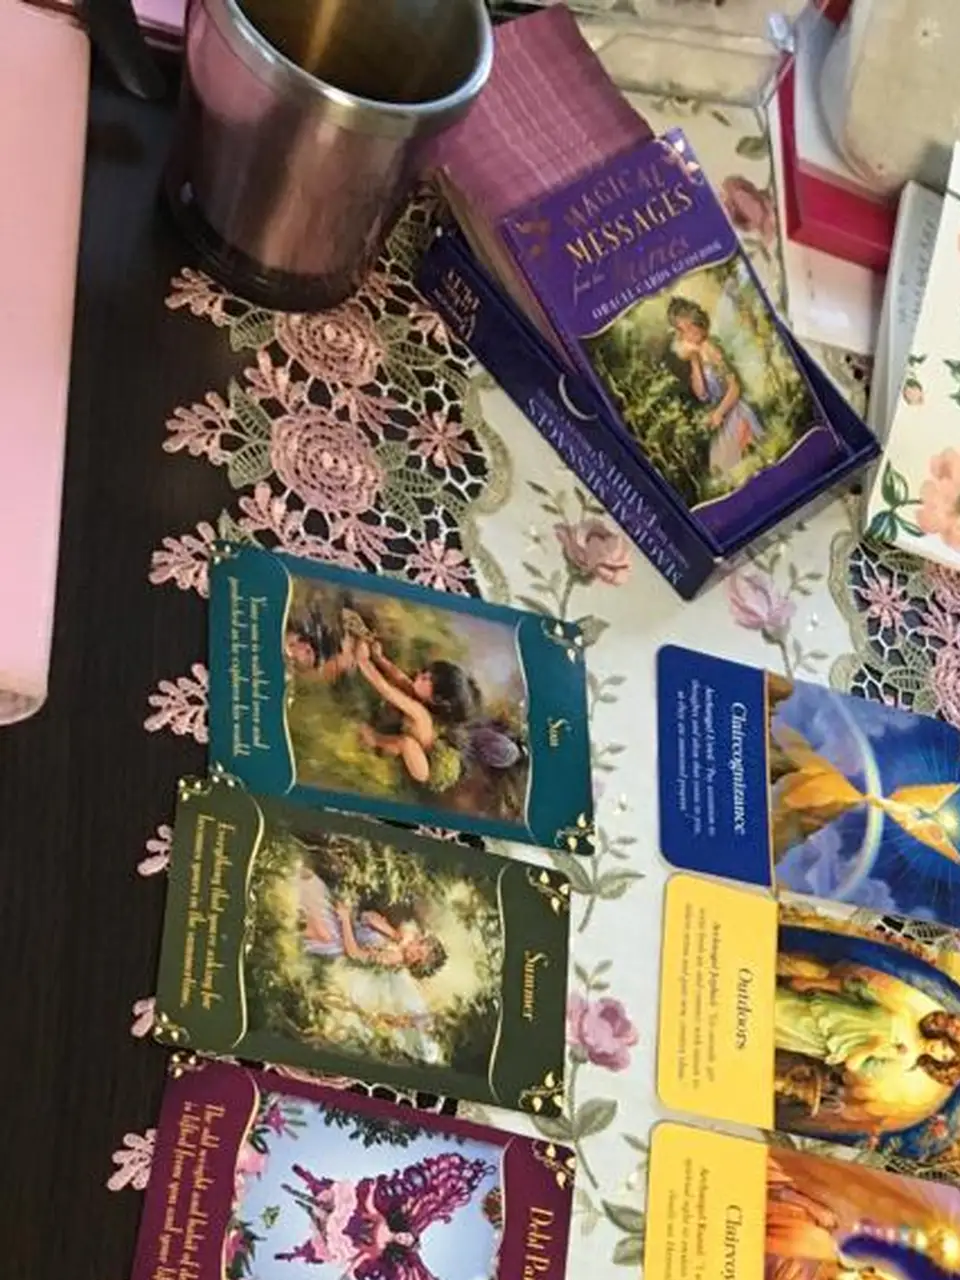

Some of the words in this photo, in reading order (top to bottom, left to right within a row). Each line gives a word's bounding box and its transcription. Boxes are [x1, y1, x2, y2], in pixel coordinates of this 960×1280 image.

[563, 164, 665, 227] MAGICAL
[566, 183, 693, 268] MESSAGES
[591, 285, 636, 320] ORACLE
[529, 399, 606, 496] MESSAGES
[594, 452, 655, 526] FAIRIES
[612, 499, 682, 584] MAGICAL
[252, 726, 270, 749] and
[729, 702, 748, 835] Claircognizance
[211, 886, 231, 912] that
[522, 950, 548, 1022] Summer
[735, 967, 753, 1051] Outdoors
[203, 1103, 225, 1123] The
[171, 1148, 196, 1180] from
[164, 1206, 183, 1233] and
[189, 1190, 209, 1218] and
[526, 1207, 554, 1250] Debt
